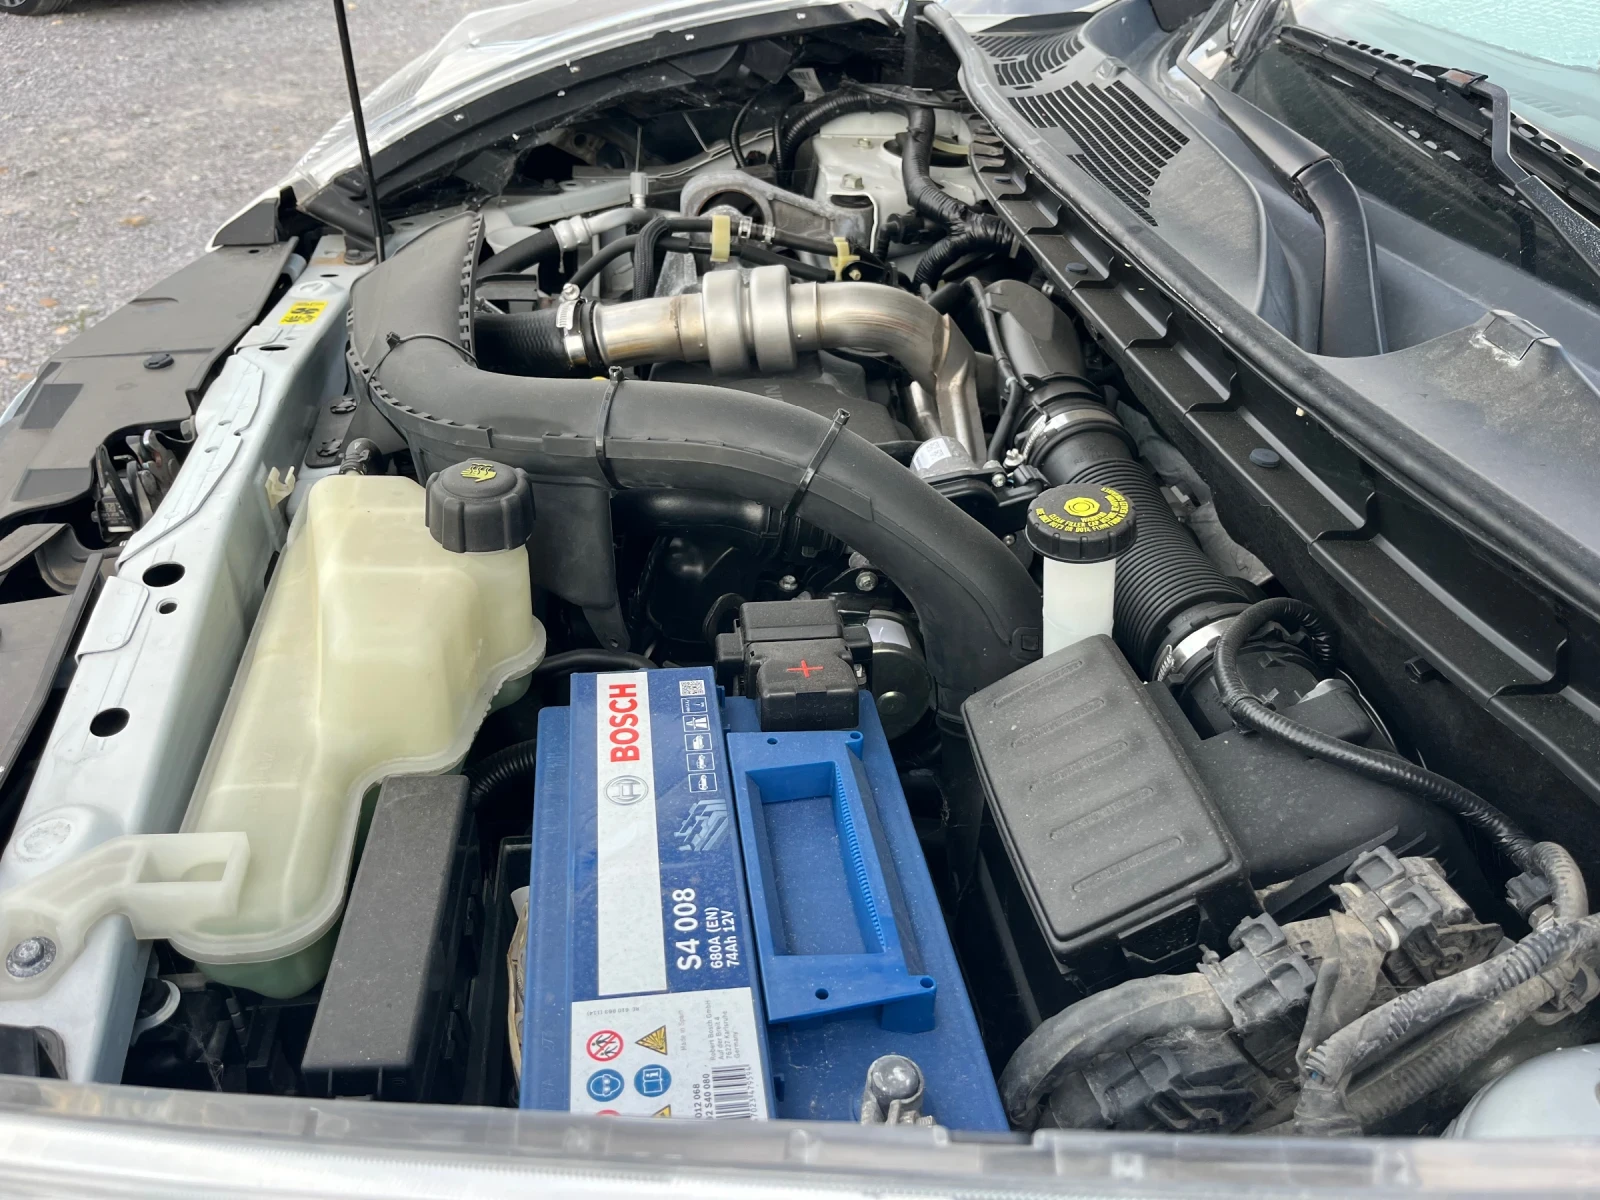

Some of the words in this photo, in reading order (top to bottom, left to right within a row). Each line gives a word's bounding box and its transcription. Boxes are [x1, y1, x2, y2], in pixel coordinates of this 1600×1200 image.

[609, 683, 640, 762] BOSCH
[672, 888, 698, 931] 008
[704, 907, 721, 932] (EN)
[720, 910, 735, 932] 12V
[675, 938, 702, 970] S4
[708, 935, 723, 969] 680A
[724, 935, 740, 967] 74Ah
[706, 1019, 714, 1038] Bosch
[722, 1010, 730, 1039] Karlsruhe
[679, 1034, 687, 1051] Made
[708, 1040, 716, 1061] Robert
[724, 1040, 732, 1059] 76227
[732, 1031, 741, 1059] Germany
[717, 1049, 725, 1060] Auf
[692, 1083, 701, 1100] 068
[702, 1073, 710, 1089] 080
[703, 1091, 712, 1108] S40
[694, 1102, 703, 1119] 012
